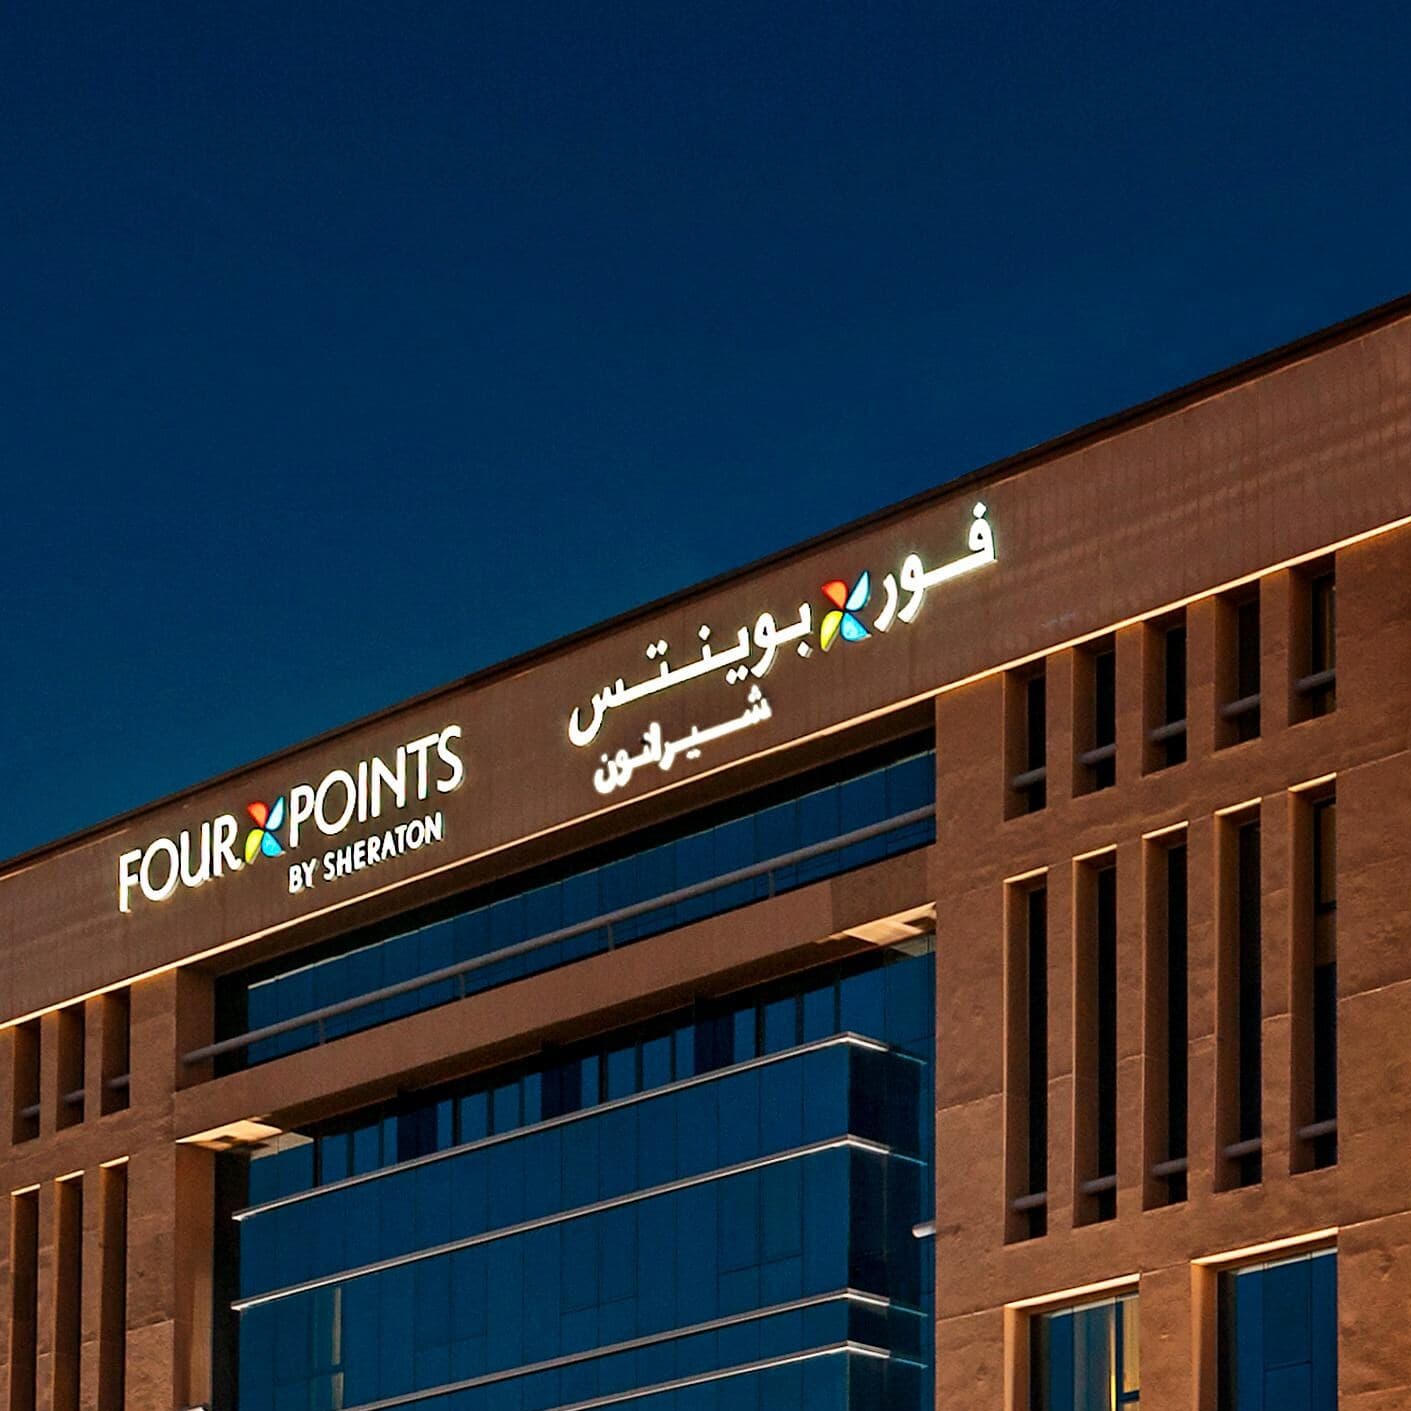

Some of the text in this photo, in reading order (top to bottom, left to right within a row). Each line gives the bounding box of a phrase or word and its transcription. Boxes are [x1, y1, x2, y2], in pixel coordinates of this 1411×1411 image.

[568, 502, 998, 747] فور بوينتس
[119, 724, 464, 914] FOUR POINTS
[288, 811, 443, 894] BY SHERATON
